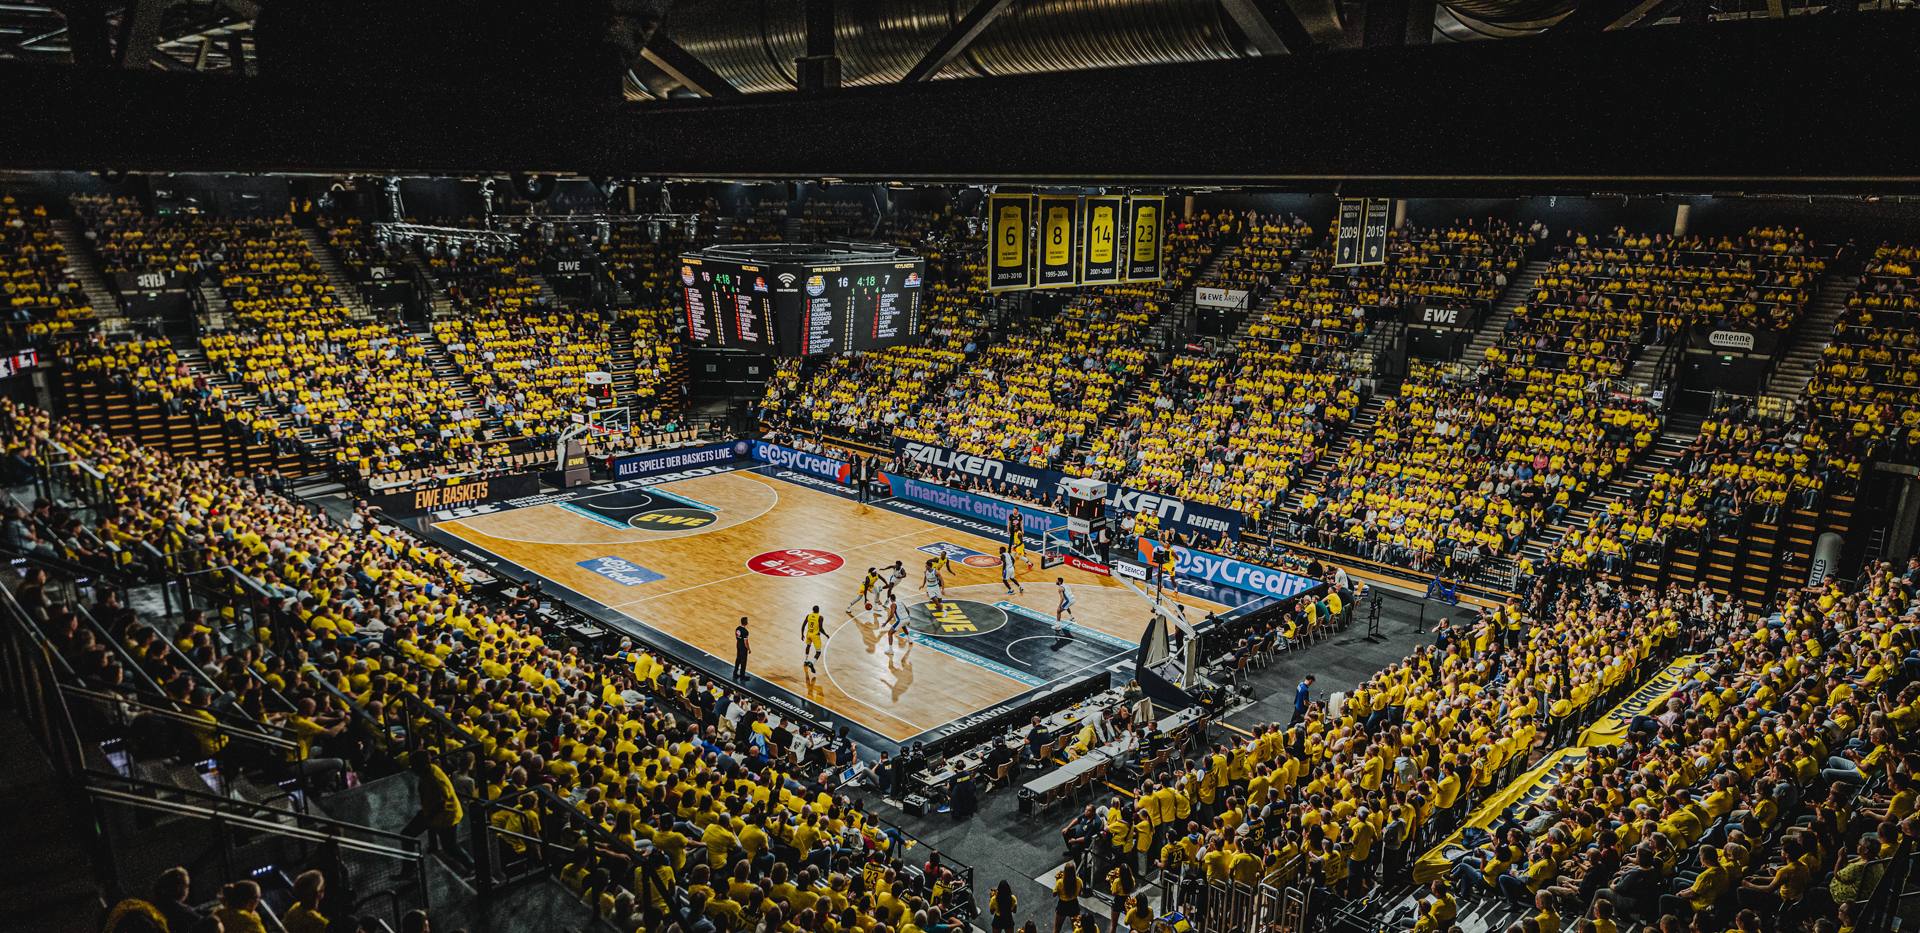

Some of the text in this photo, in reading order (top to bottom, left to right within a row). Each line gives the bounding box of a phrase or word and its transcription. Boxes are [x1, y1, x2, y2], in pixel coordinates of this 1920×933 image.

[1006, 226, 1015, 246] 6
[1053, 226, 1062, 245] 8
[1095, 225, 1111, 244] 14
[1138, 225, 1153, 242] 23
[1341, 226, 1357, 238] 2009
[1367, 226, 1384, 237] 2015
[558, 261, 580, 271] EWE
[716, 273, 730, 285] 4:18
[736, 276, 741, 286] 7
[838, 277, 848, 287] 16
[857, 276, 875, 286] 4:18
[885, 275, 890, 284] 7
[1423, 308, 1458, 323] EWE
[568, 458, 584, 466] EWE
[619, 448, 732, 475] ALLE SPIELE DER BASKETS LIVE.
[903, 442, 1038, 489] FALKEN REIFEN
[415, 488, 440, 509] EWE
[443, 482, 488, 505] BASKETS
[904, 479, 972, 511] finanziert
[636, 513, 711, 526] EWE
[886, 501, 912, 510] EWE
[912, 507, 963, 524] BASKETS
[1187, 514, 1230, 532] REIFEN
[1124, 566, 1145, 576] SEMCO
[925, 602, 978, 632] EWE
[939, 705, 1014, 736] TRANSPORT
